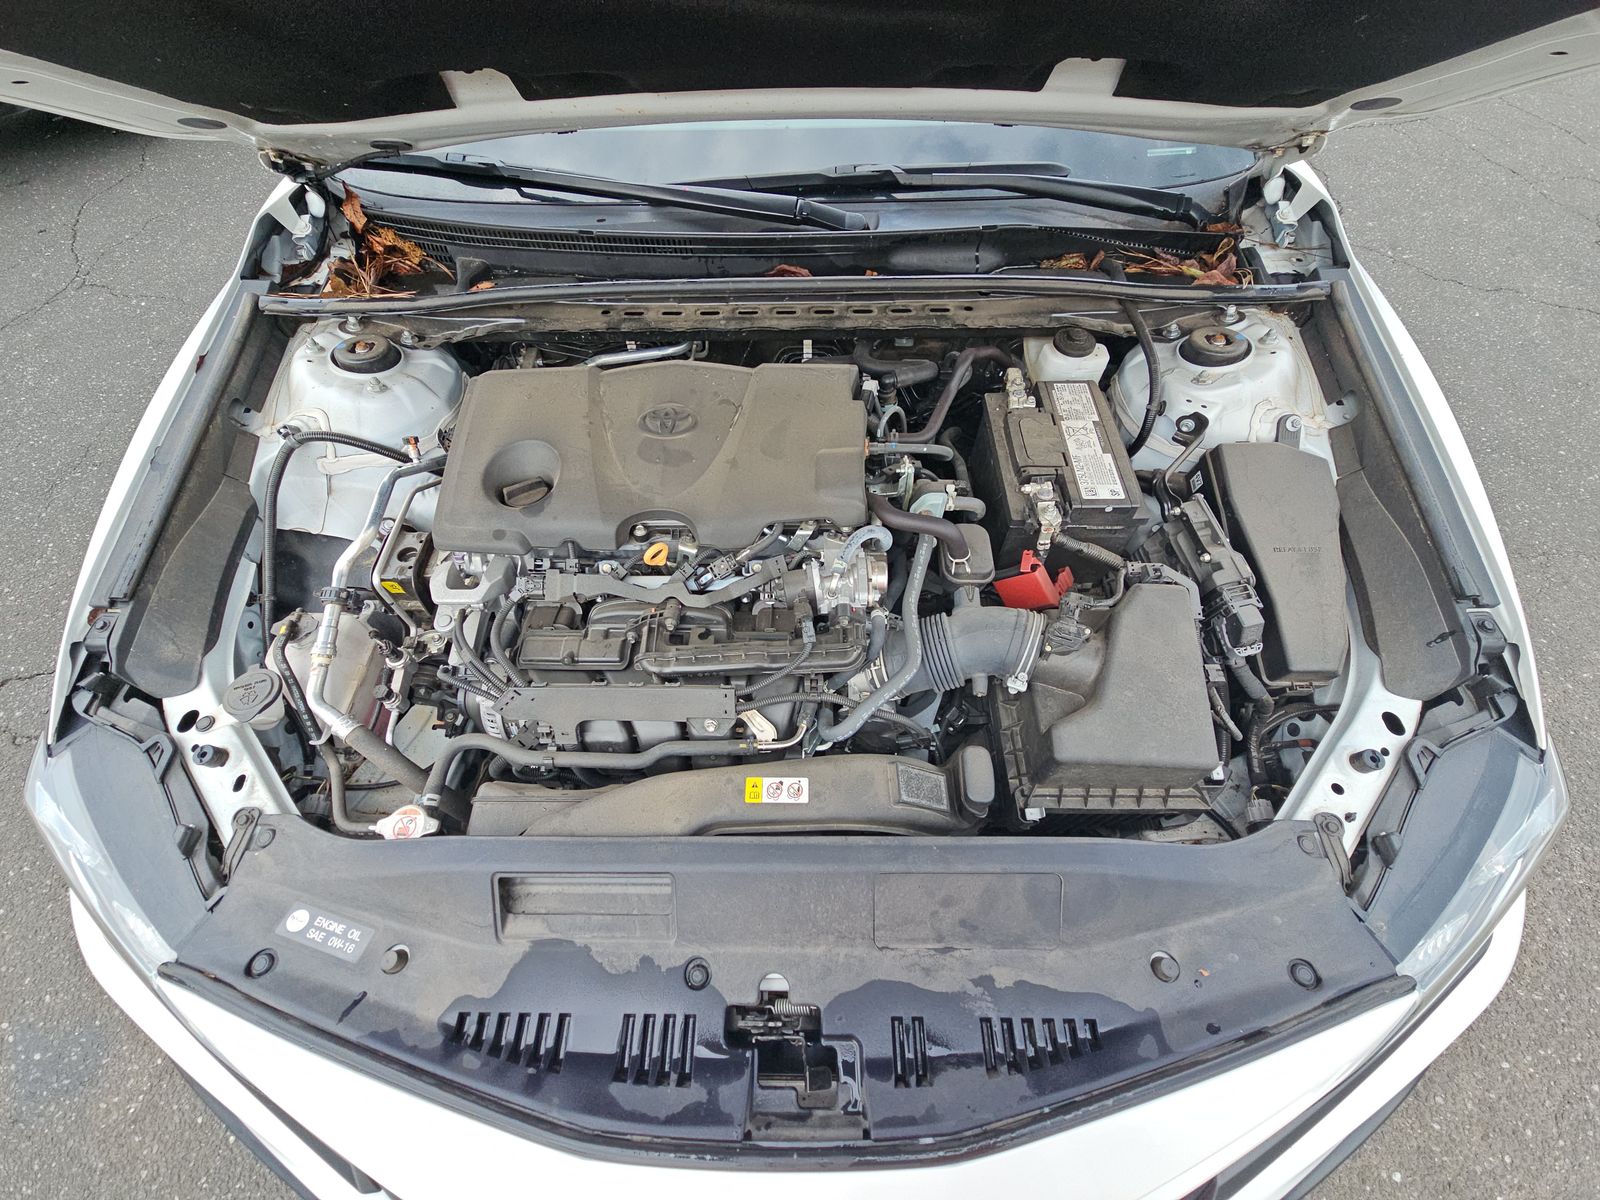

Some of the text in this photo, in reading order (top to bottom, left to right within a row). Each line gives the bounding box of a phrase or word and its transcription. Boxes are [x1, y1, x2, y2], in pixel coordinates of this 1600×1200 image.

[306, 928, 355, 953] SAE 0W-16
[313, 916, 362, 942] ENGINE OIL
